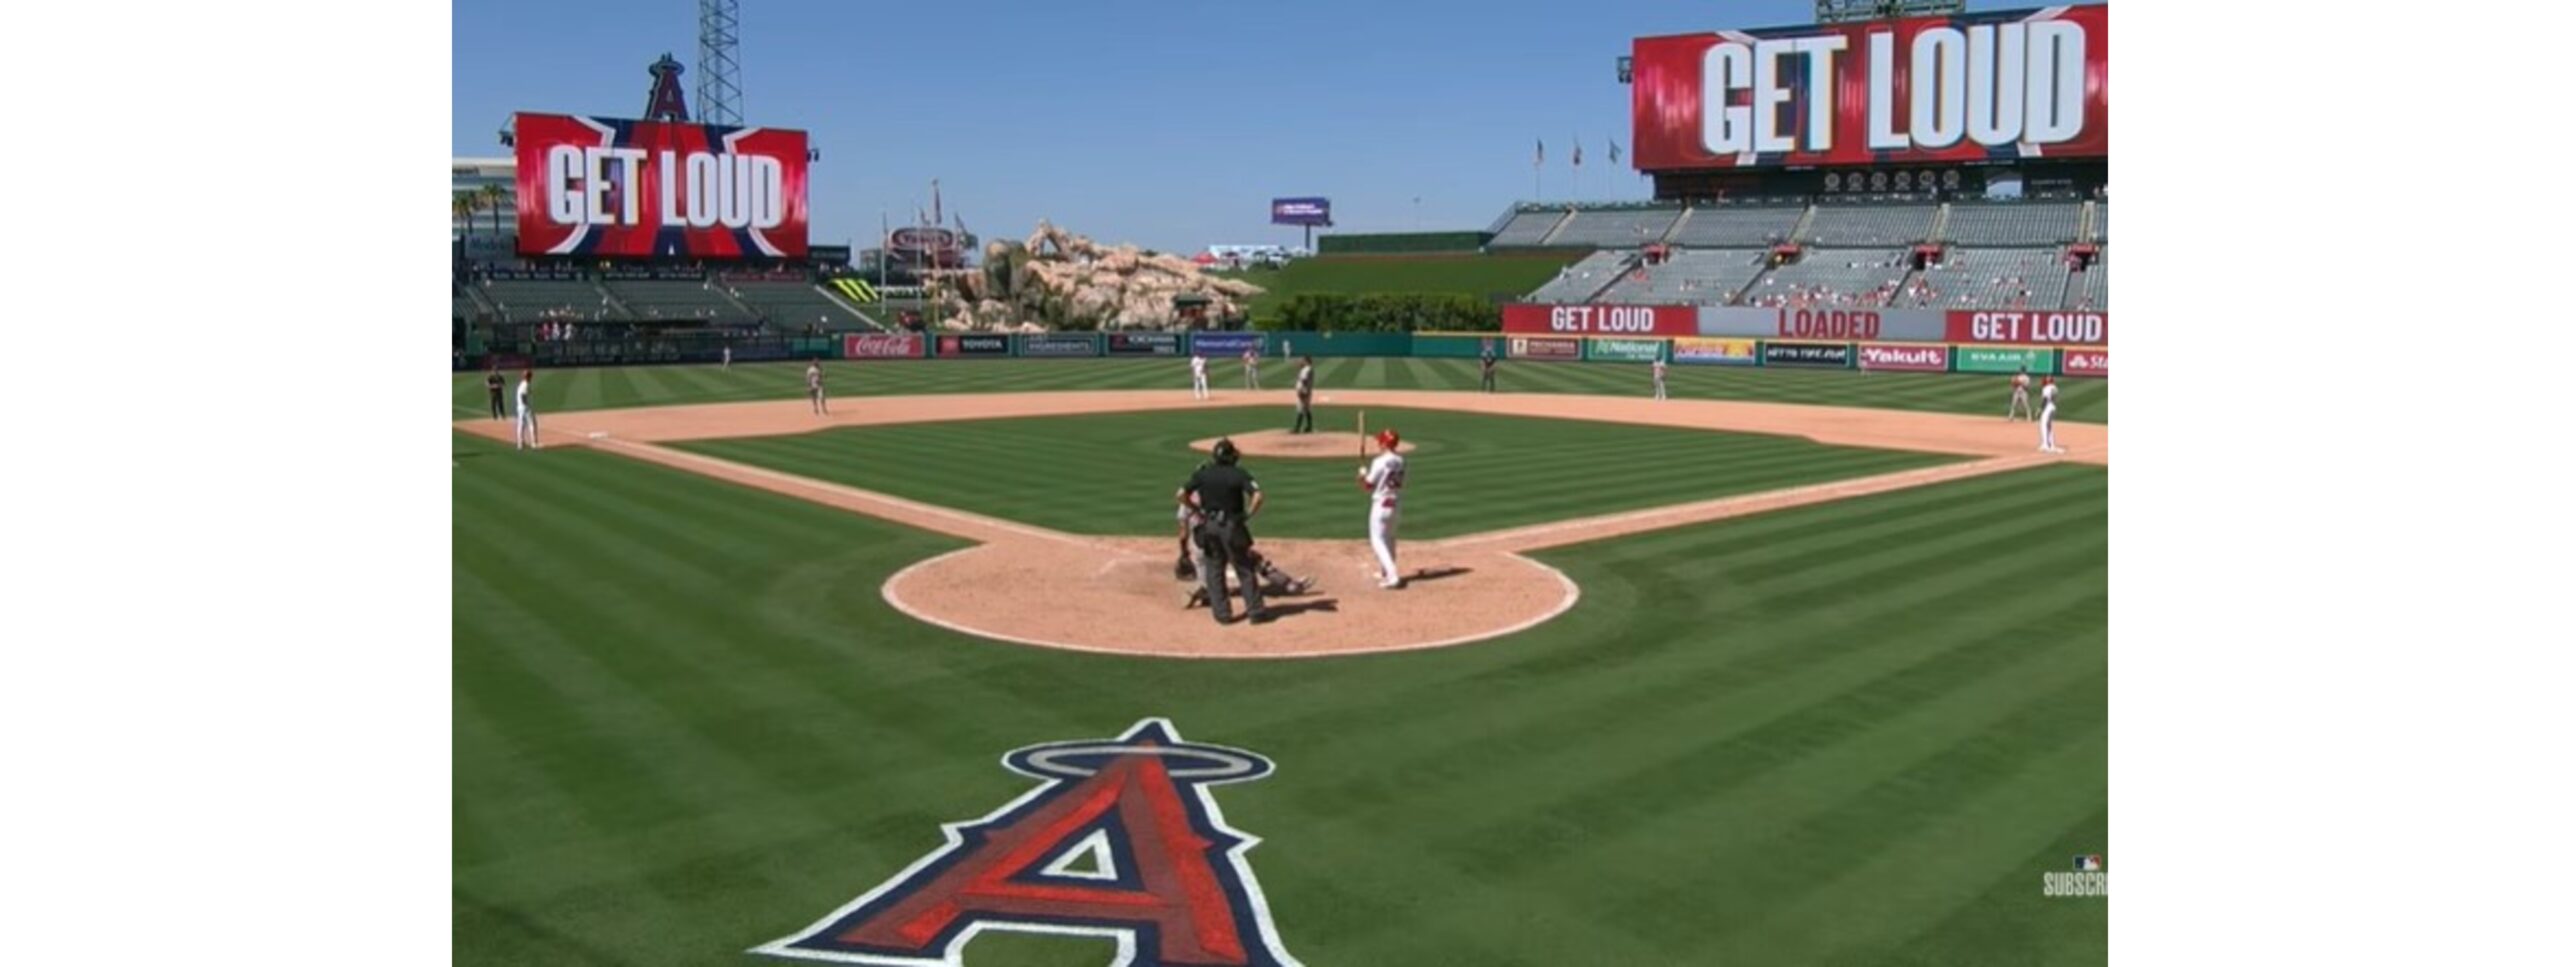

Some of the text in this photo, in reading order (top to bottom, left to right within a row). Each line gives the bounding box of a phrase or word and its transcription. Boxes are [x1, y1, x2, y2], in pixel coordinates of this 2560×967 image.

[1703, 20, 2086, 155] GET LOUD
[549, 144, 783, 229] GET LOUD
[1551, 307, 1655, 332] GET LOUD
[1778, 310, 1880, 339] LOADED
[1972, 313, 2102, 342] GET LOUD
[962, 339, 1003, 349] TOYOTA
[1865, 349, 1942, 365] Yakult
